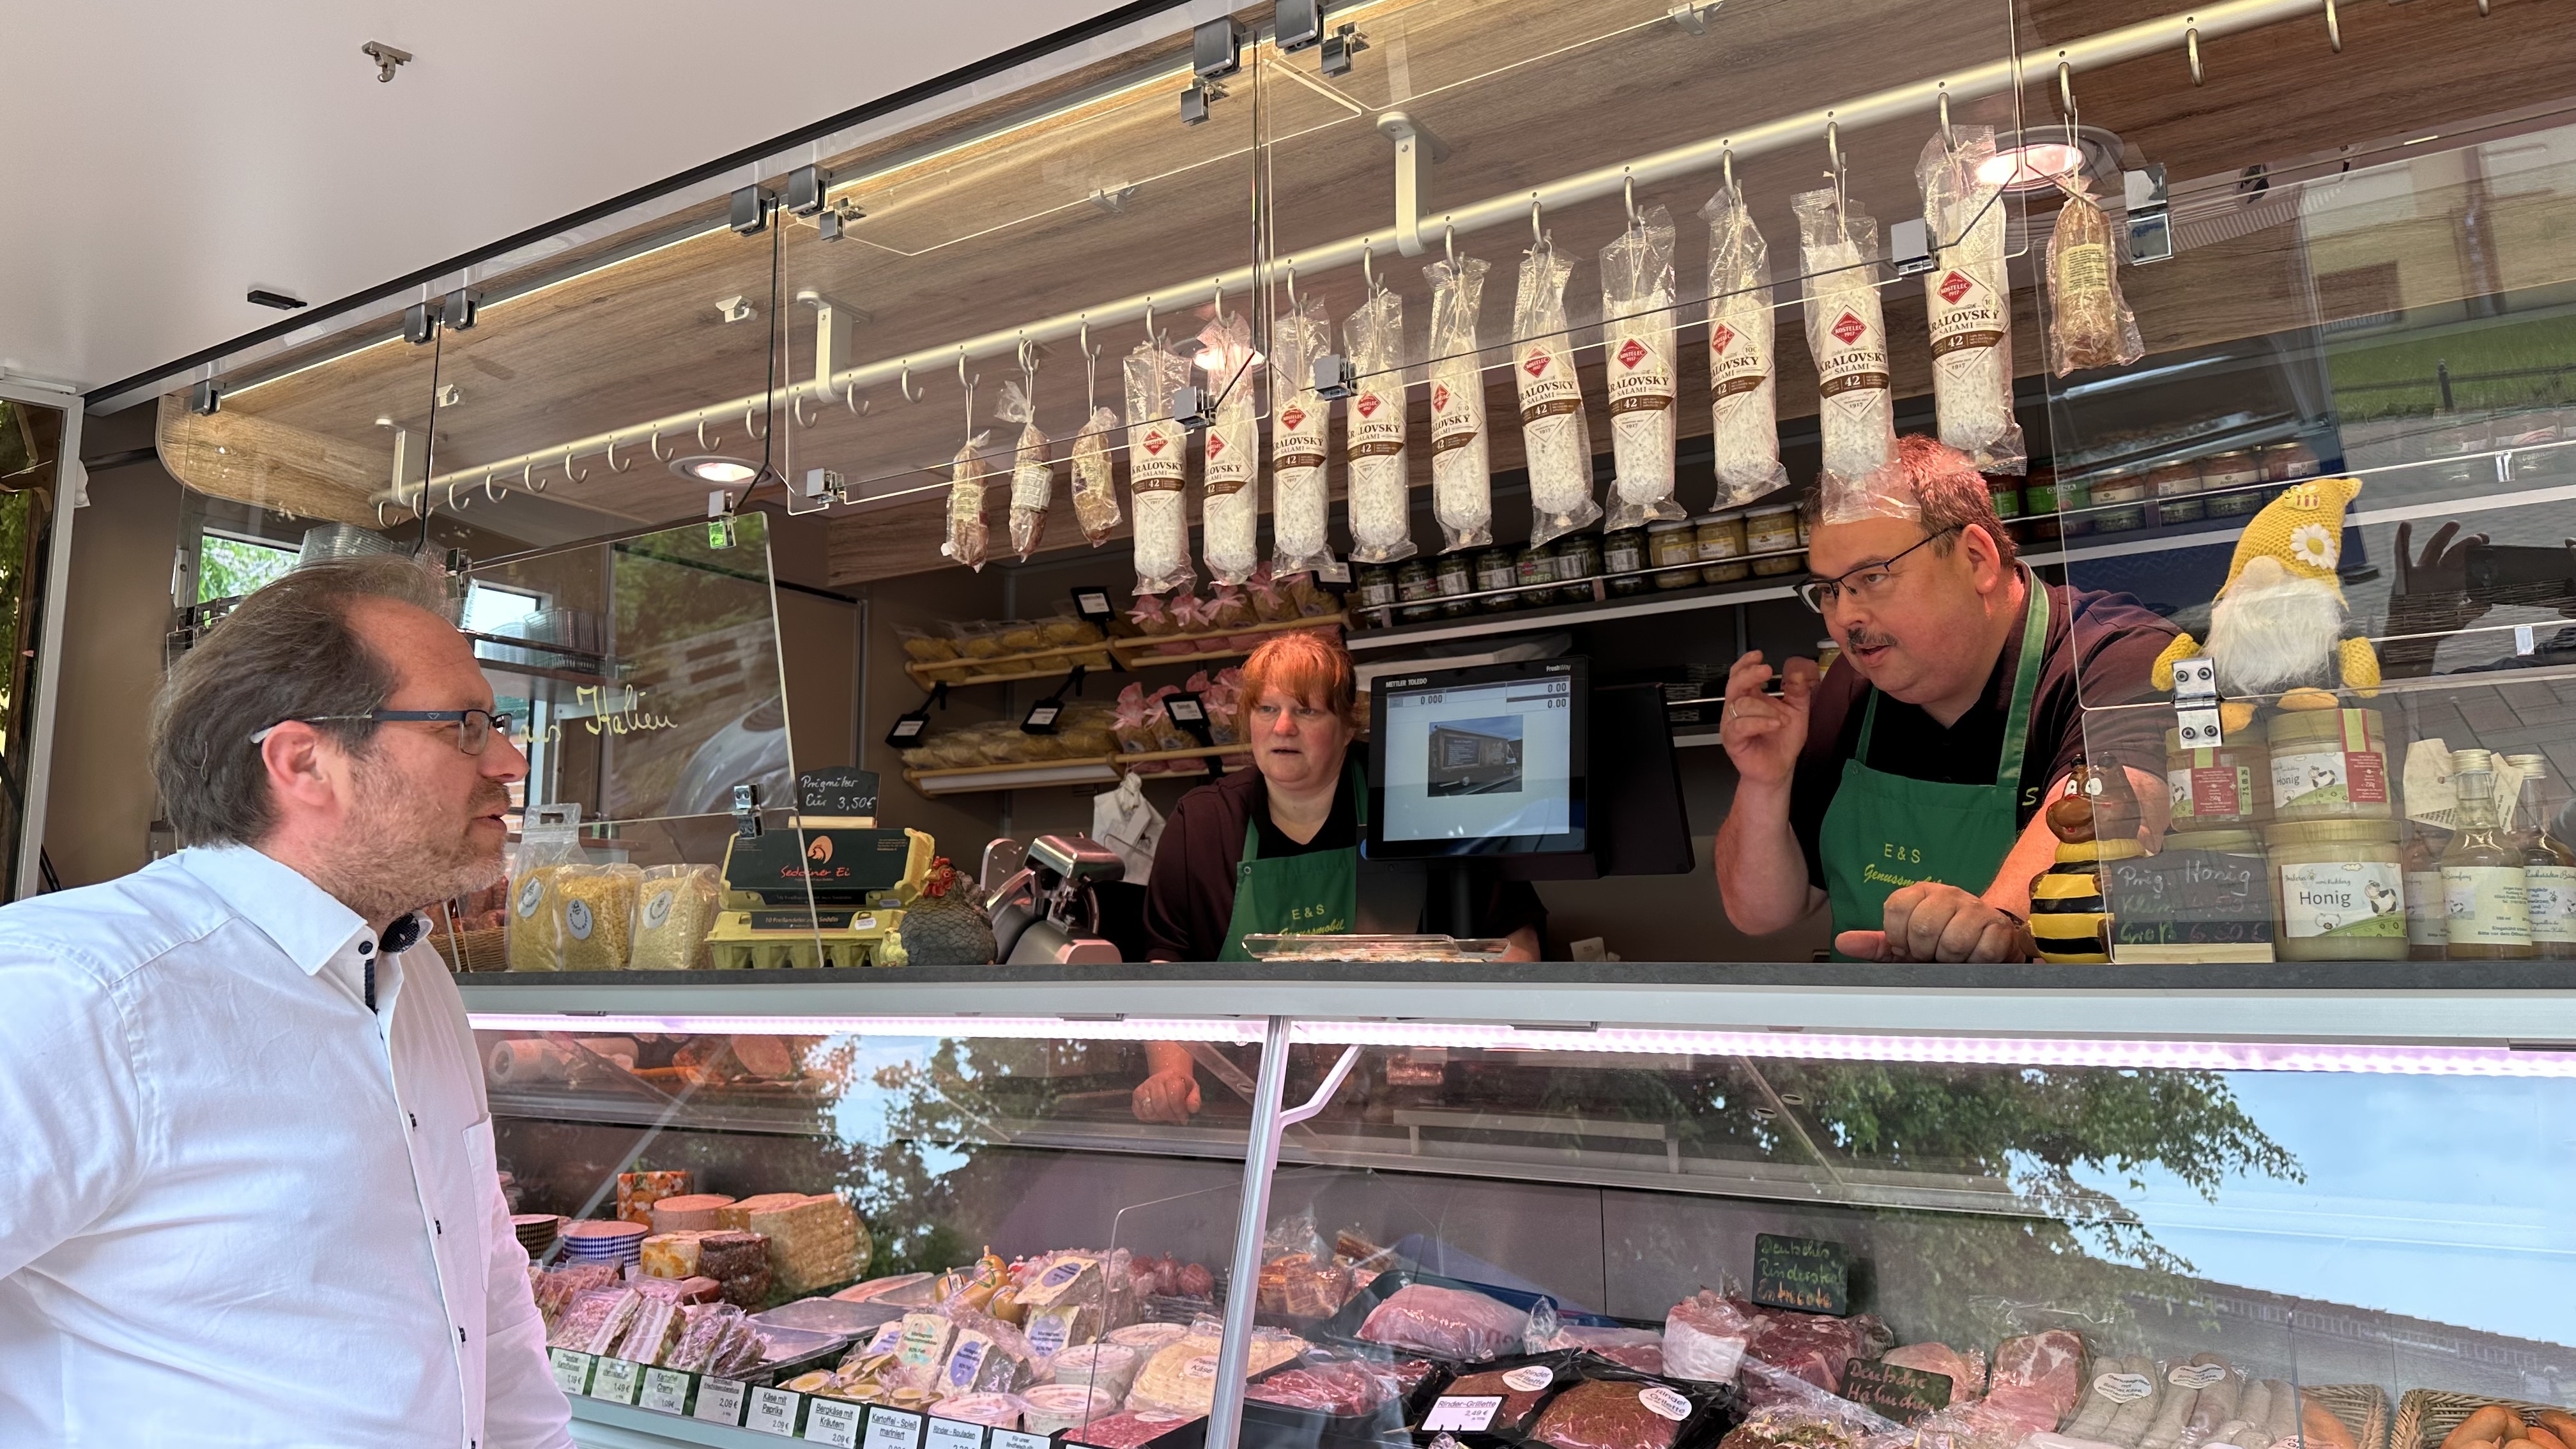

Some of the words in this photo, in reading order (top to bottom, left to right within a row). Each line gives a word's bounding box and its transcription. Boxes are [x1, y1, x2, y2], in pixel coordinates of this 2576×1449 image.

[1940, 282, 1968, 294] KOSTELEC
[1835, 325, 1862, 334] KOSTELEC
[1939, 322, 1974, 337] SALAMI
[1947, 335, 1963, 348] 42
[1834, 363, 1869, 375] SALAMI
[1844, 375, 1860, 387] 42
[1617, 387, 1646, 397] SALAMI
[1717, 383, 1727, 395] 42
[1527, 392, 1554, 406] SALAMI
[1623, 397, 1637, 408] 42
[1535, 404, 1547, 415] 42
[1280, 445, 1305, 454] SALAMI
[1361, 443, 1372, 454] 42
[1285, 455, 1297, 465] 42
[1142, 470, 1167, 478] SALAMI
[1148, 479, 1160, 487] 42
[1407, 677, 1427, 686] TOLEDO
[1547, 682, 1567, 693] 0.00
[1420, 694, 1443, 705] 0.000
[1547, 698, 1567, 709] 0.00
[2276, 775, 2300, 786] Honig
[2021, 786, 2039, 806] S
[1883, 843, 1894, 858] E
[1897, 846, 1906, 861] &
[1911, 848, 1920, 864] S
[835, 867, 851, 877] Ei
[2186, 859, 2251, 896] Honig
[2299, 890, 2351, 908] Honig
[1292, 908, 1301, 920] E
[1304, 907, 1314, 918] &
[1316, 904, 1324, 915] S
[1190, 1365, 1213, 1374] Käse
[1523, 1369, 1550, 1379] Rinder
[763, 1392, 778, 1402] Käse
[778, 1395, 787, 1405] mit
[1655, 1389, 1687, 1406] Rinder
[733, 1400, 739, 1409] €
[762, 1404, 783, 1416] Paprika
[815, 1403, 843, 1416] Bergkäse
[843, 1410, 854, 1420] mit
[785, 1422, 789, 1430] €
[871, 1413, 896, 1425] Kartoffel
[900, 1418, 917, 1430] Spieß
[880, 1427, 905, 1439] mariniert
[933, 1425, 949, 1435] Rinder
[953, 1428, 976, 1439] Rouladen
[845, 1436, 850, 1445] €
